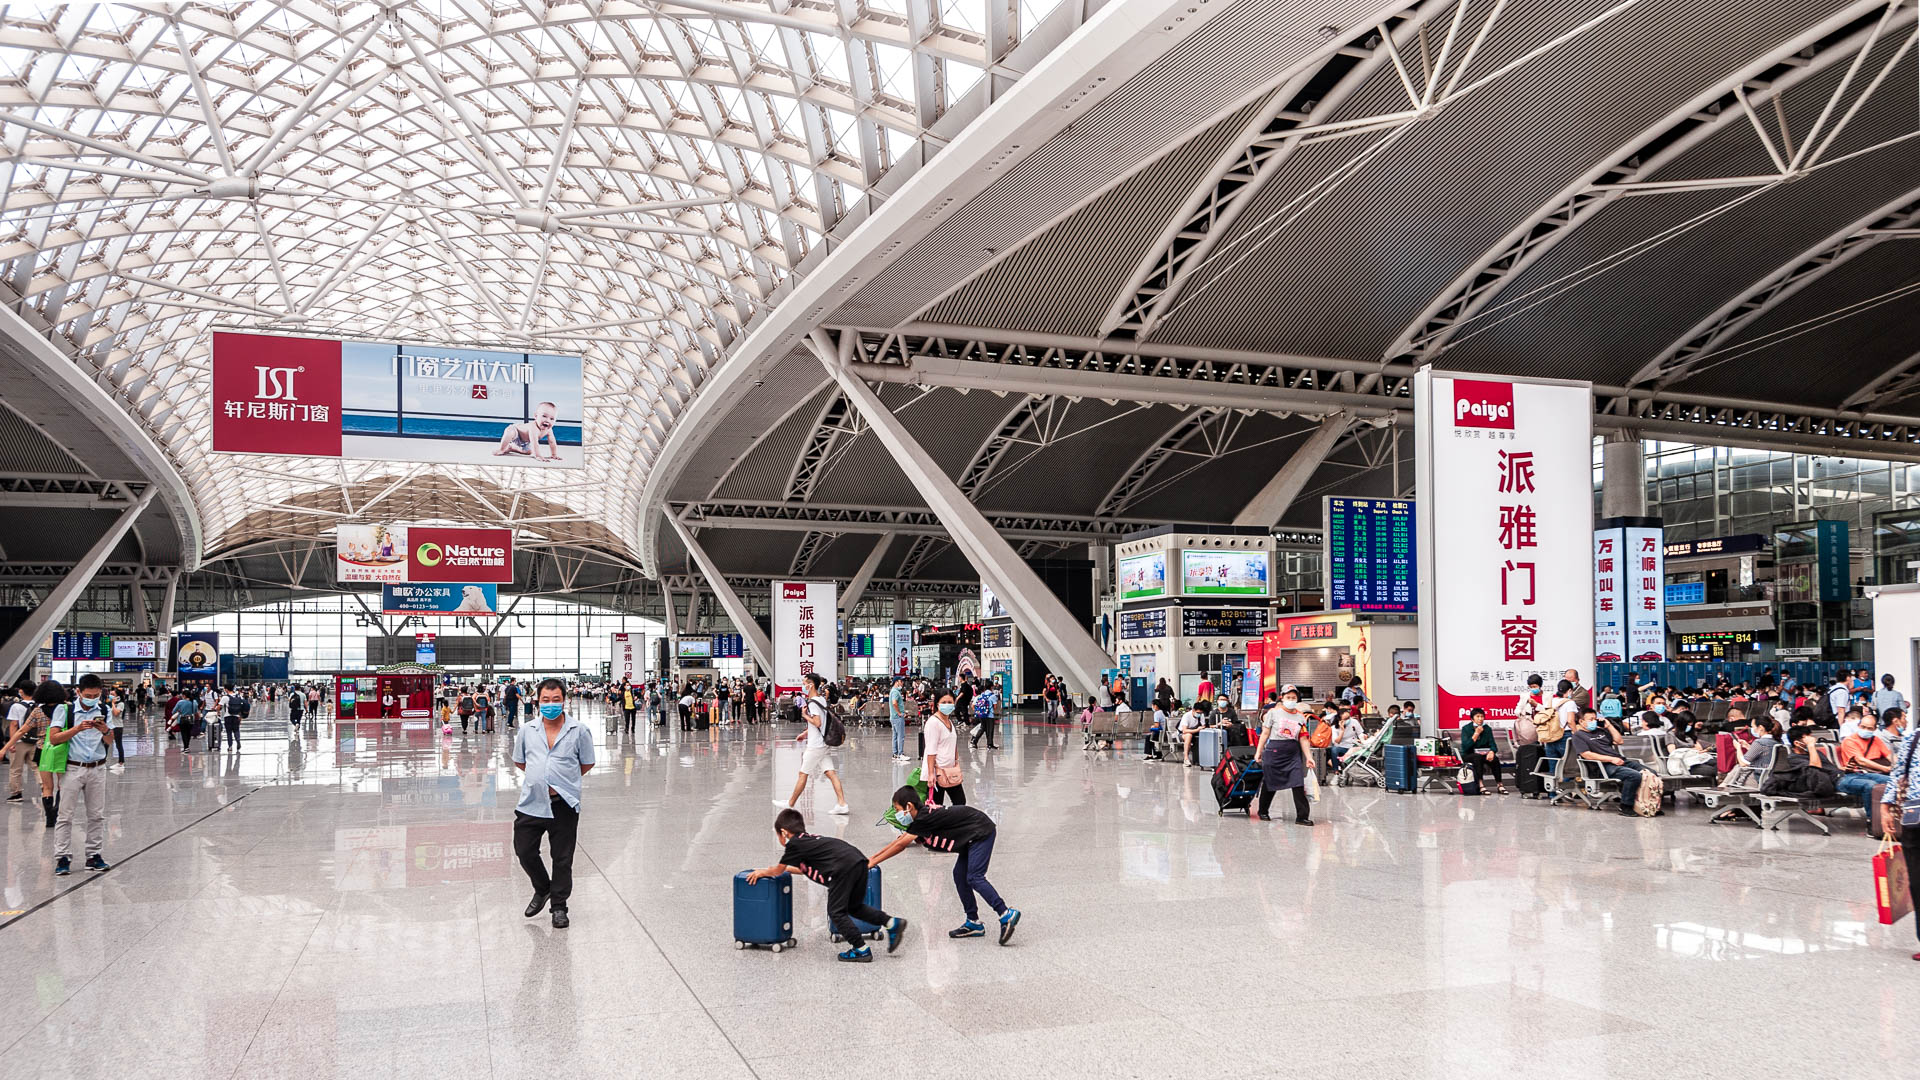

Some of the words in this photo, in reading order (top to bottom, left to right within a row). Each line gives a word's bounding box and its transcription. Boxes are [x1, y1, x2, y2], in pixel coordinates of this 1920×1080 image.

[392, 354, 534, 384] 门窗艺术大师
[224, 400, 329, 422] 轩尼斯门窗
[1456, 398, 1511, 421] Paiya
[445, 544, 505, 557] Nature
[1497, 449, 1538, 662] 派雅门窗
[445, 557, 505, 567] 大自然地板
[1598, 538, 1614, 612] 万顺叫车
[1641, 537, 1656, 611] 万顺叫车
[784, 589, 806, 597] Paiya
[963, 623, 984, 631] KFC
[1736, 633, 1751, 643] B14
[799, 605, 814, 675] 派雅门窗
[1682, 635, 1697, 644] B15
